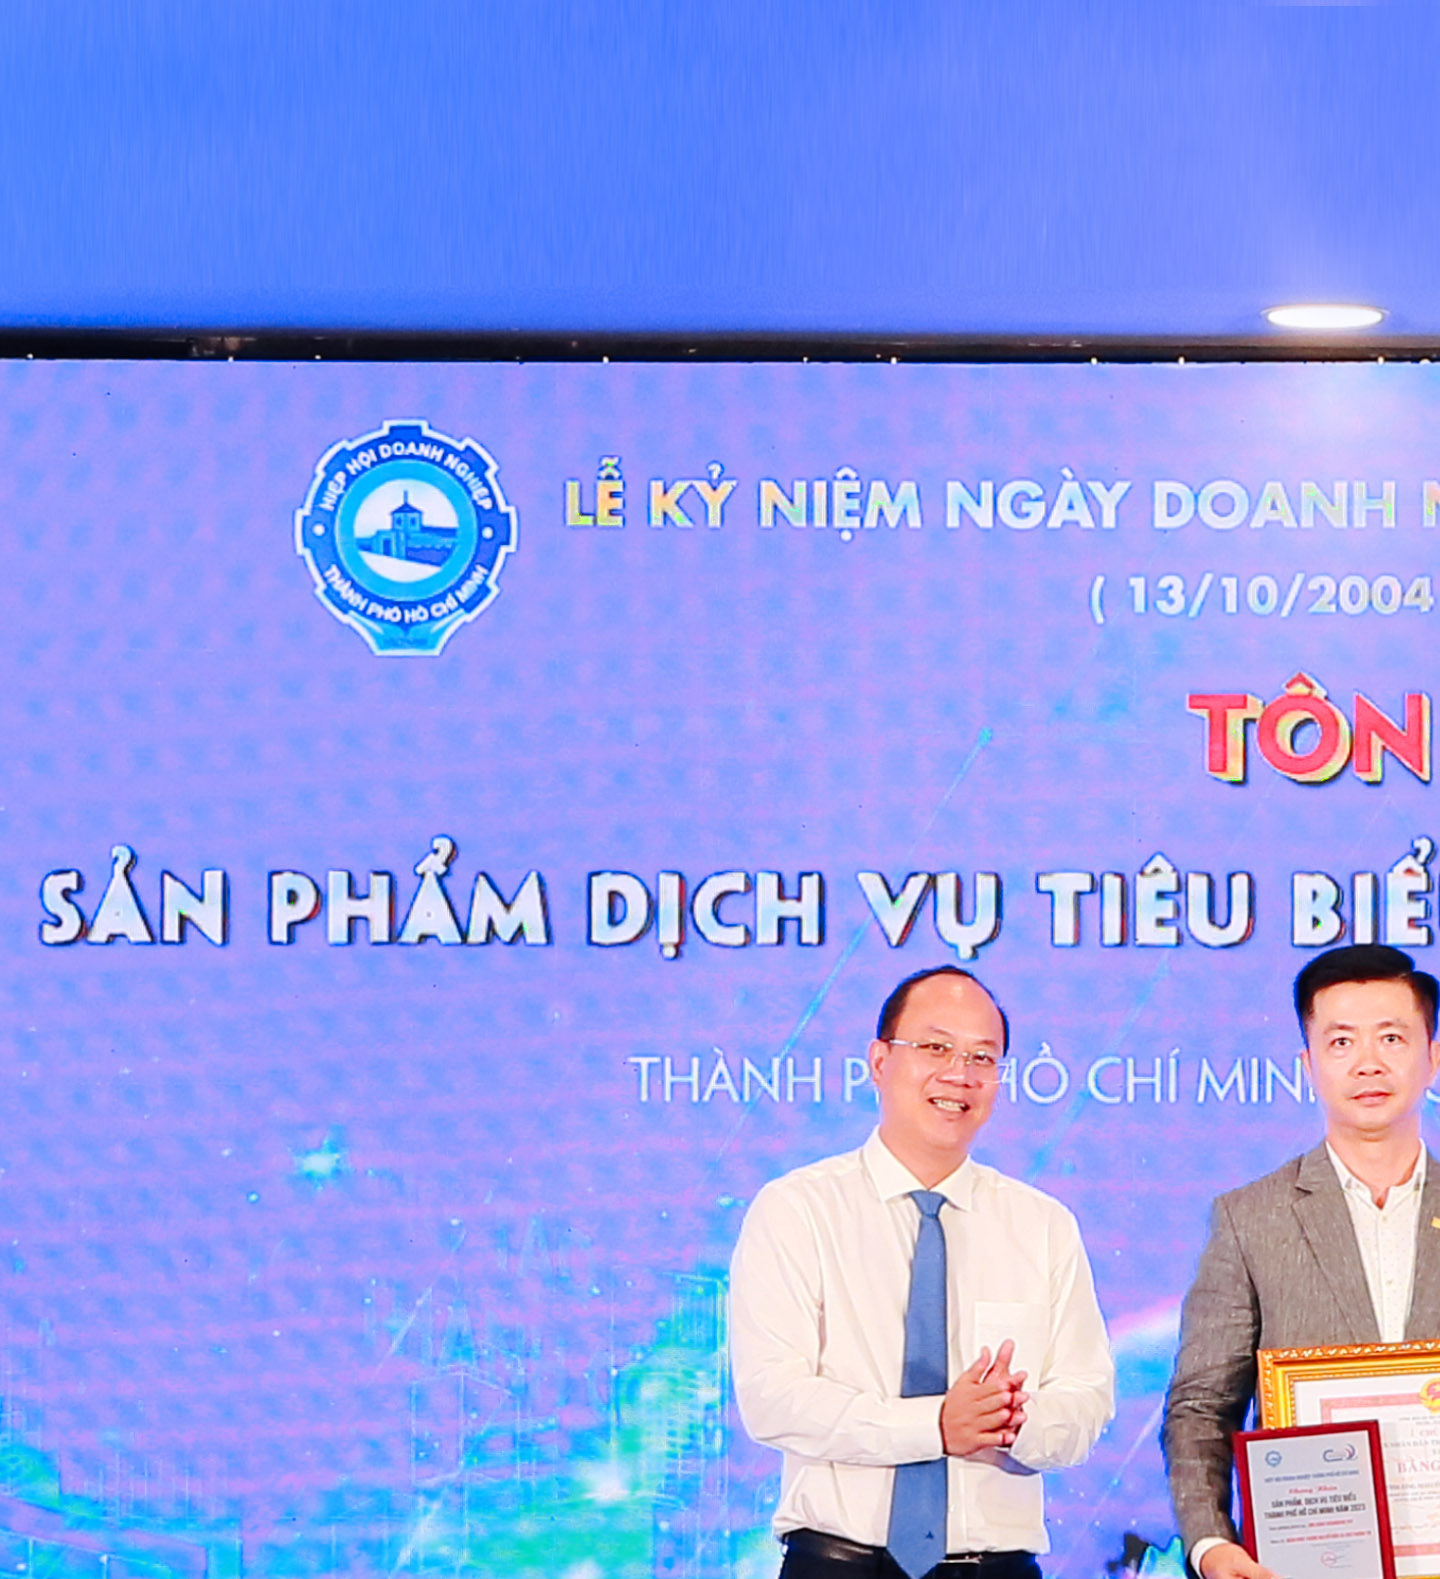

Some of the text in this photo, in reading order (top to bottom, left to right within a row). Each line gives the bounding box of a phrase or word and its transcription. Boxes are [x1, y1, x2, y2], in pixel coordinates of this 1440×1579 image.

[378, 441, 444, 462] DOANH
[565, 456, 624, 528] LỄ
[650, 461, 737, 528] KỶ
[760, 466, 922, 542] NIỆM
[946, 464, 1131, 529] NGÀY
[1154, 477, 1398, 529] DOANH
[1128, 575, 1434, 617] 13/10/2004
[1186, 670, 1433, 784] TÔN
[39, 845, 228, 947] SẢN
[268, 834, 552, 947] PHẨM
[587, 869, 826, 960] DỊCH
[857, 869, 1003, 960] VỤ
[1037, 852, 1255, 948] TIÊU
[628, 1046, 823, 1104] THÀNH
[1088, 1047, 1178, 1104] CHÍ
[1197, 1056, 1317, 1104] MIN
